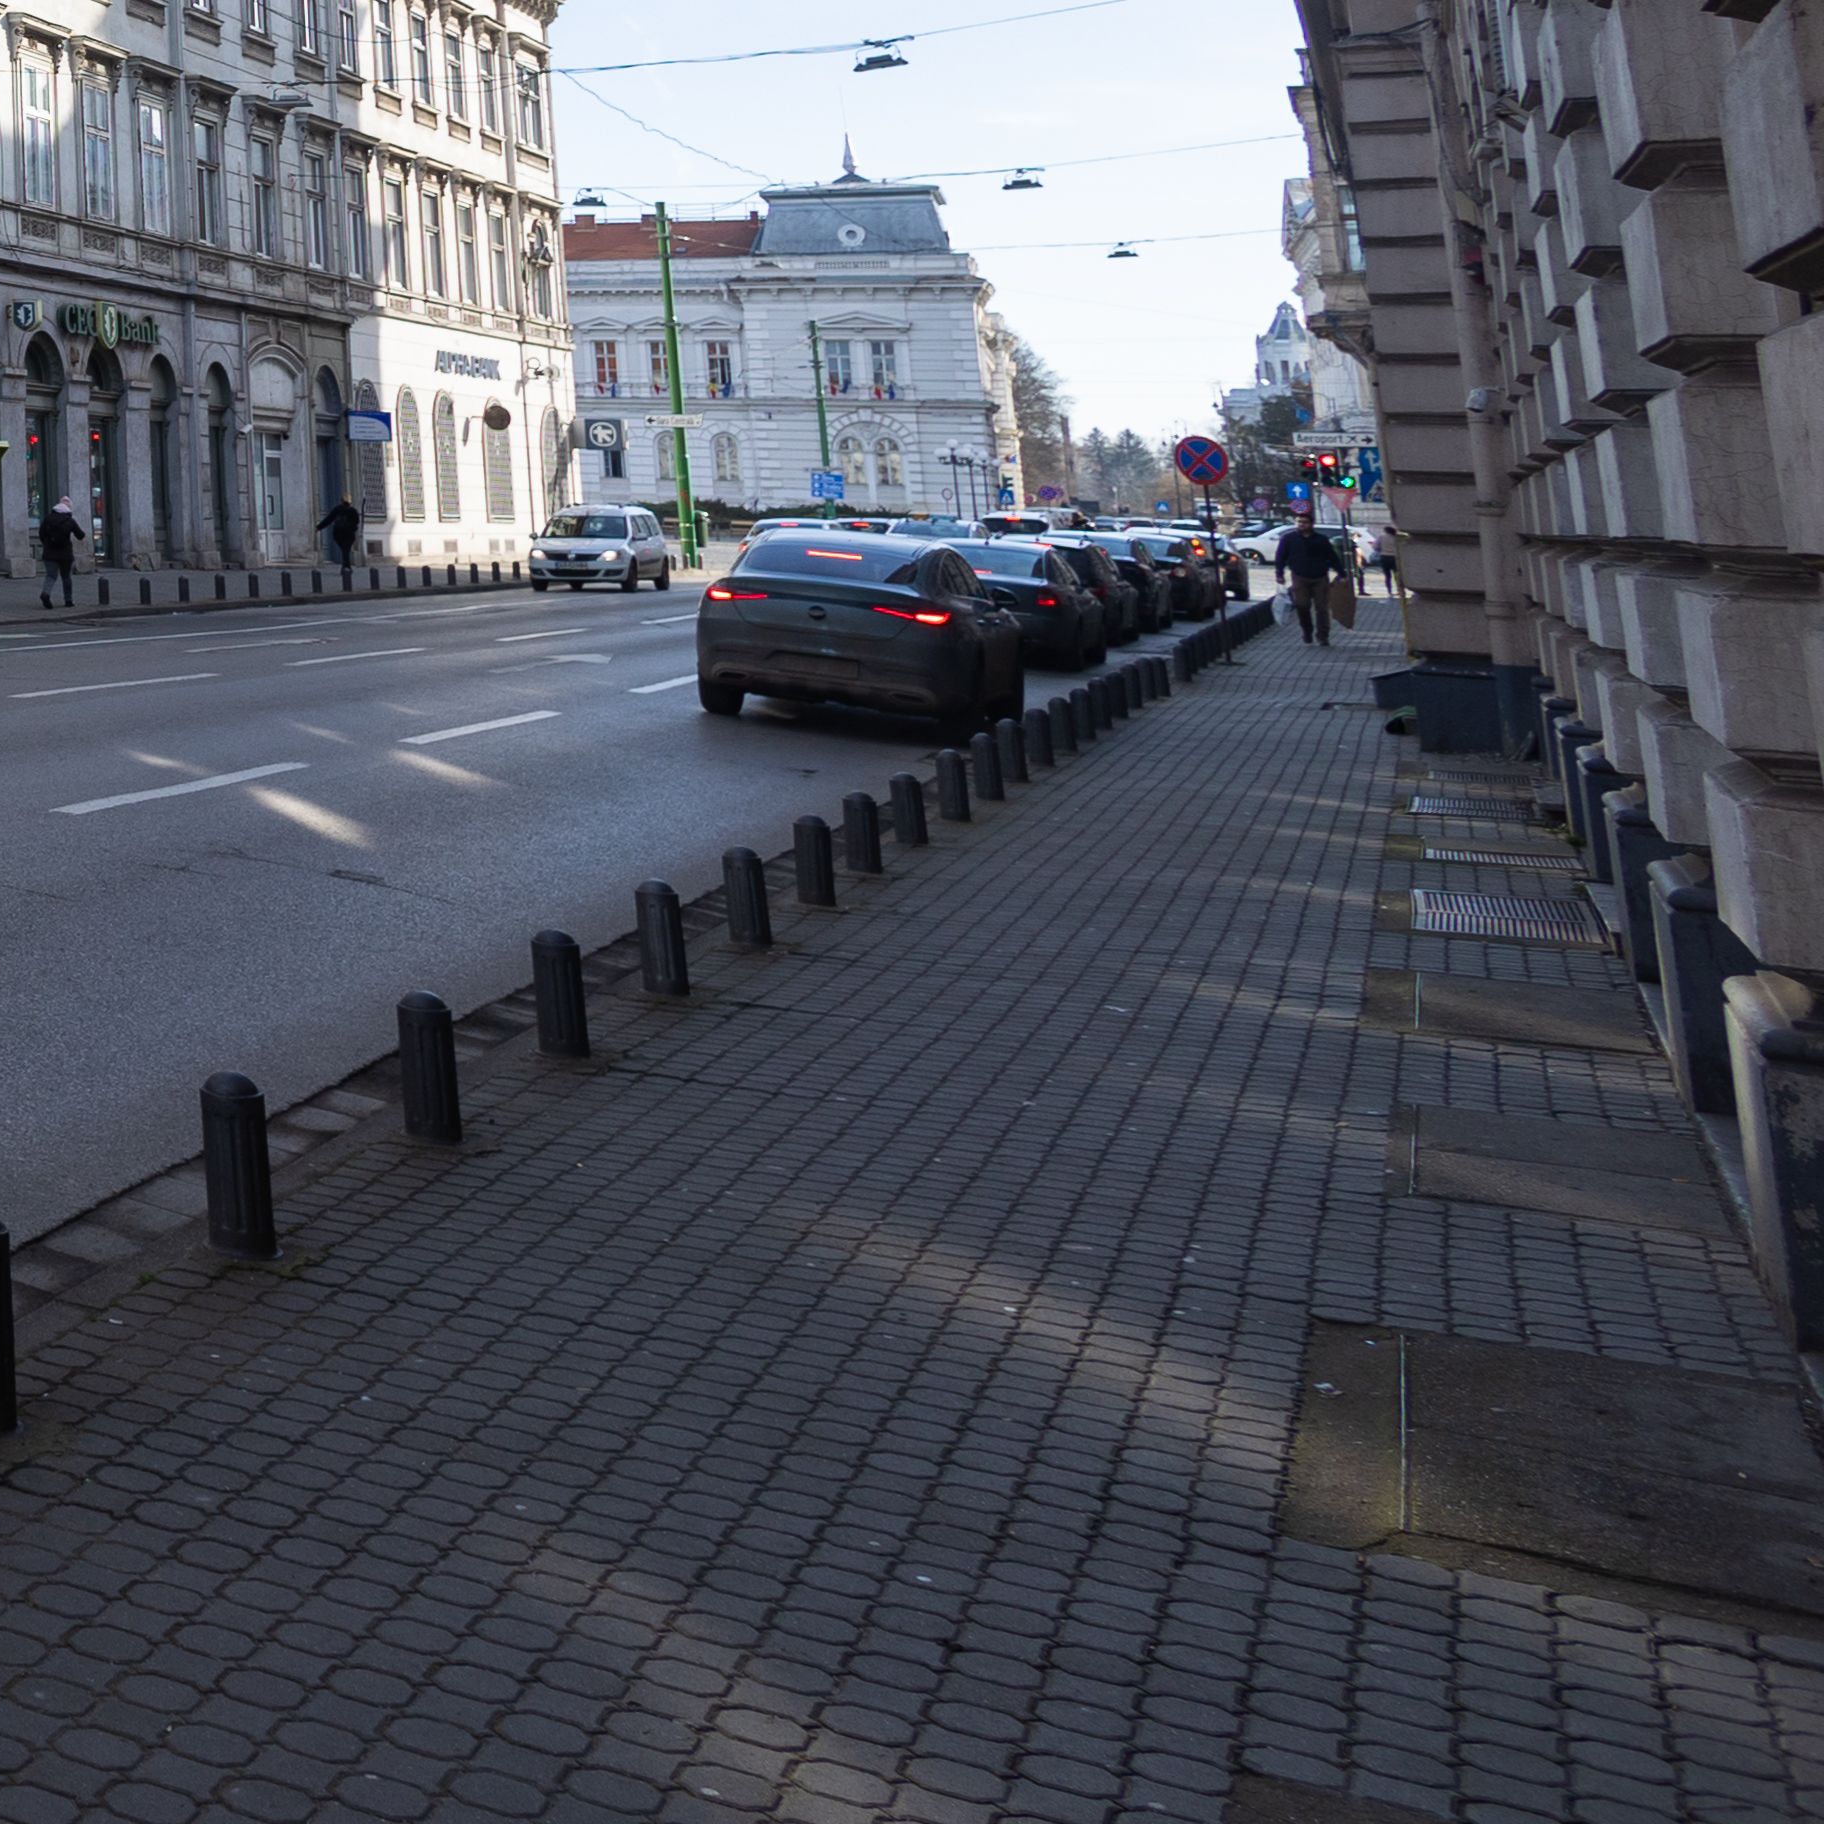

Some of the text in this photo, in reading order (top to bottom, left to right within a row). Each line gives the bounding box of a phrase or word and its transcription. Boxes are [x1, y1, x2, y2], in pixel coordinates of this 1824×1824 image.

[63, 303, 160, 345] CEC Bank
[1297, 434, 1343, 445] Aeroport
